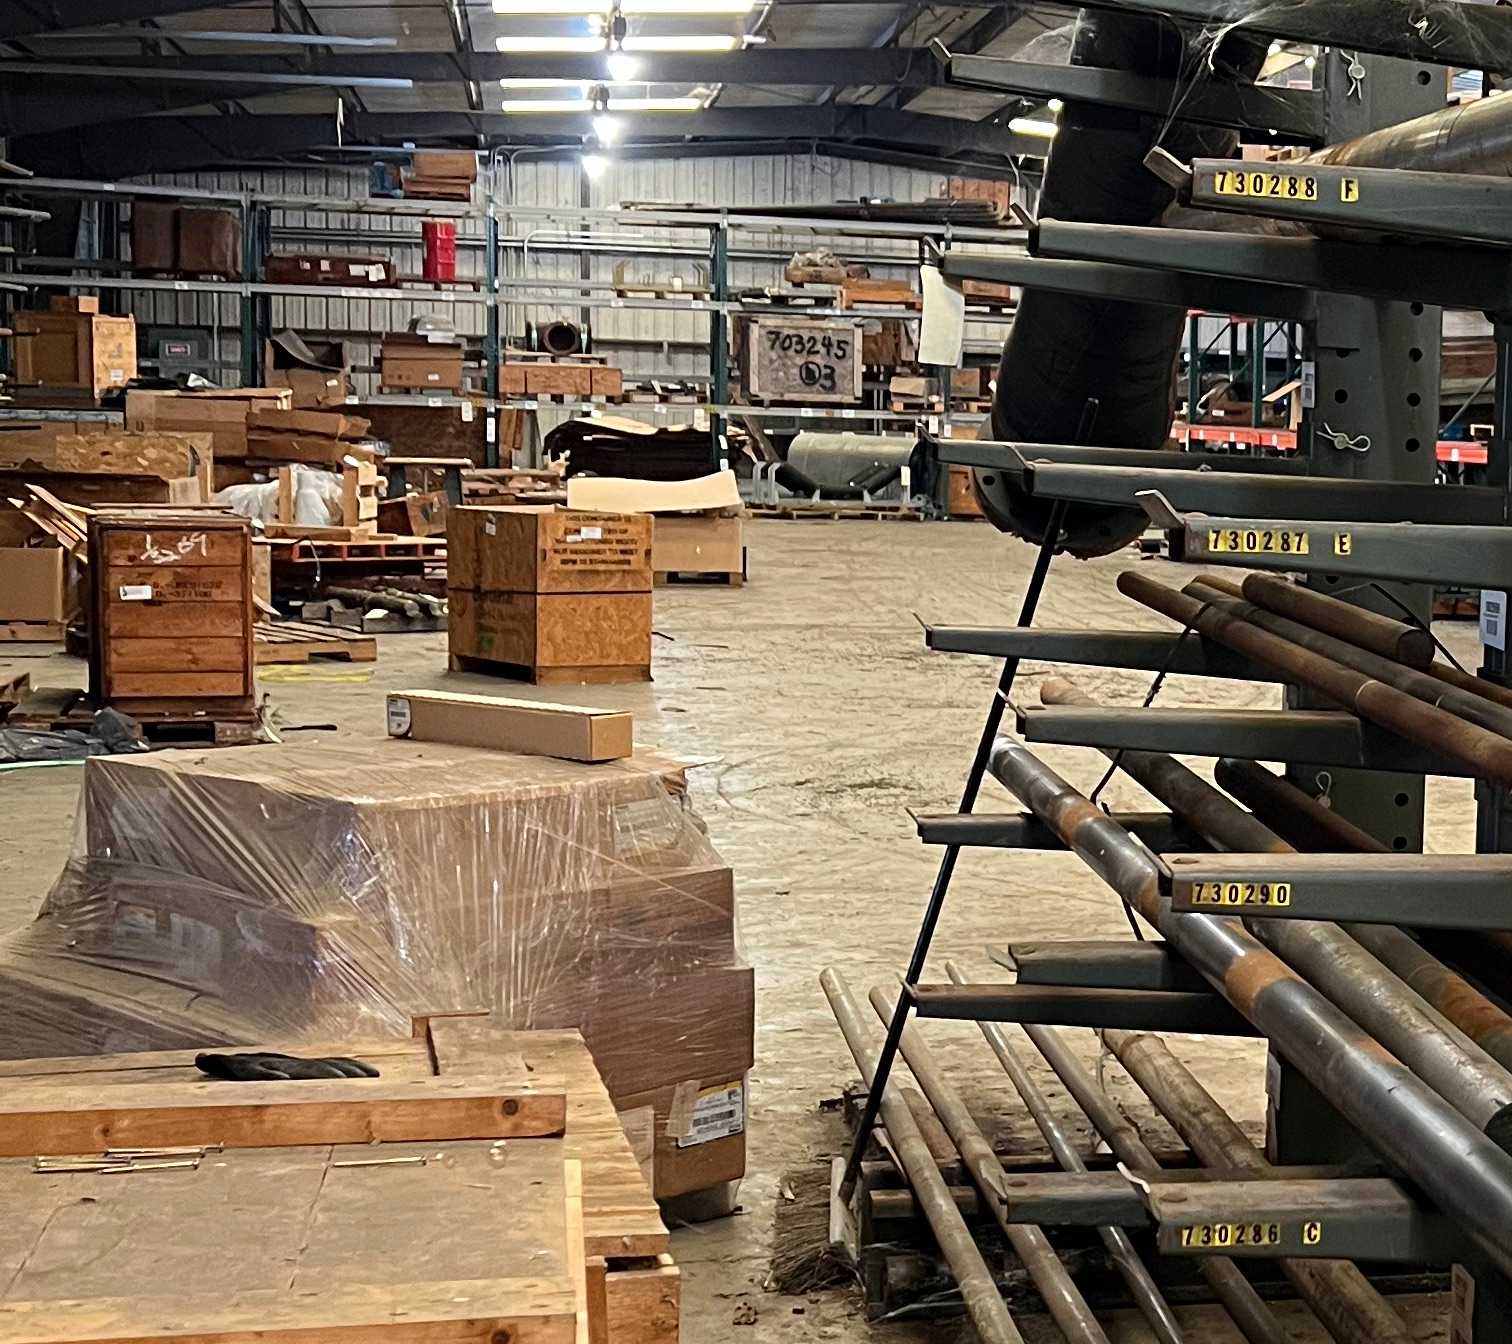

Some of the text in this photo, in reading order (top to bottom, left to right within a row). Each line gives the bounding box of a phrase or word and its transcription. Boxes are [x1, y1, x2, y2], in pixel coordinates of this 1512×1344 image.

[1217, 171, 1354, 200] 730288 F
[766, 330, 849, 360] 703245
[1211, 529, 1350, 554] 730287 E
[1194, 882, 1288, 905] 730290
[1183, 1221, 1319, 1246] 730286 C
